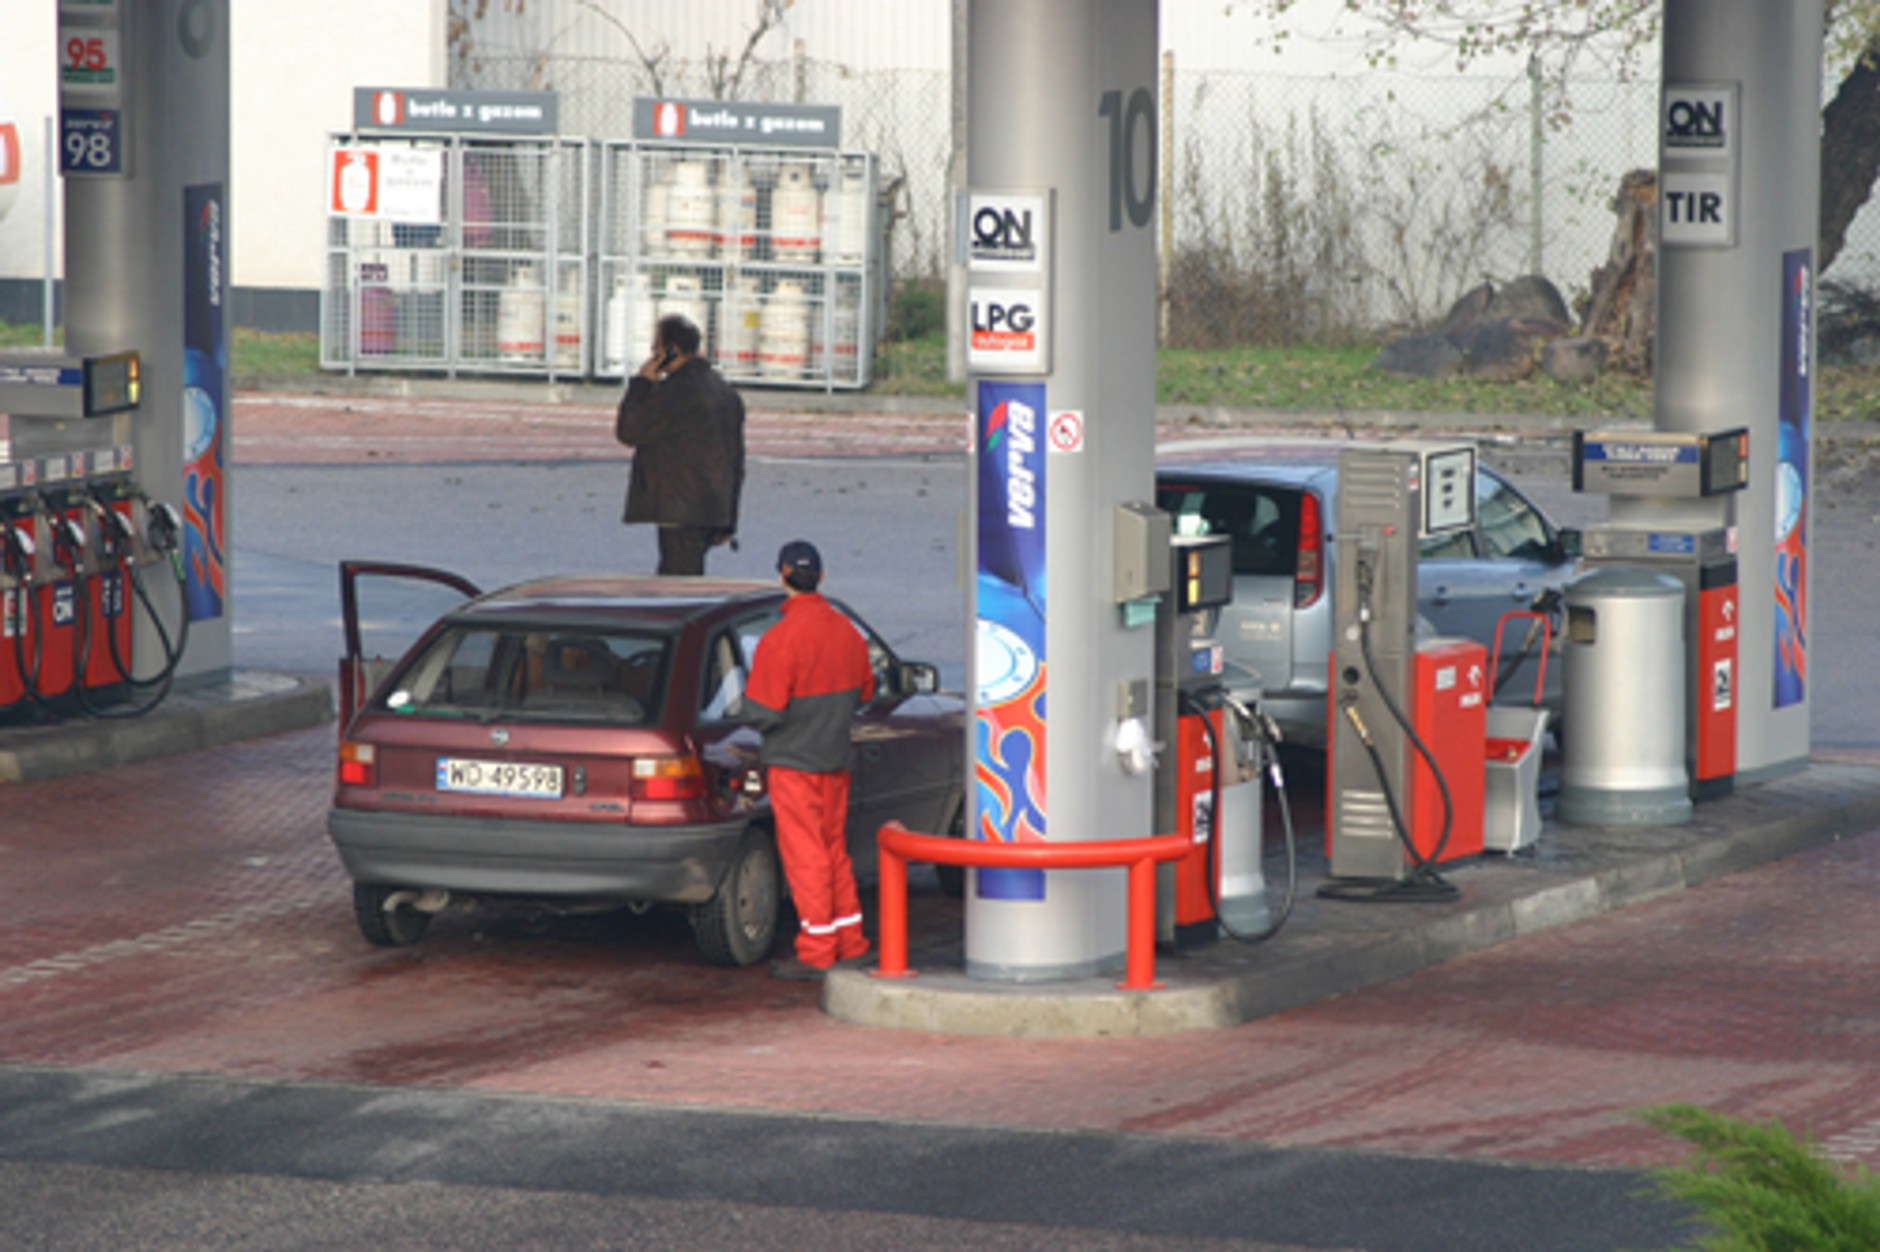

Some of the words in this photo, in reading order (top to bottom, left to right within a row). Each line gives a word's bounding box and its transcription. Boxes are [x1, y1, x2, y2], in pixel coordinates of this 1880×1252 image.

[66, 38, 107, 70] 95
[1669, 101, 1723, 136] ON
[66, 132, 111, 167] 98
[1098, 86, 1158, 232] 10
[1665, 192, 1722, 223] TIR
[973, 207, 1032, 248] ON
[972, 302, 1035, 332] LPG
